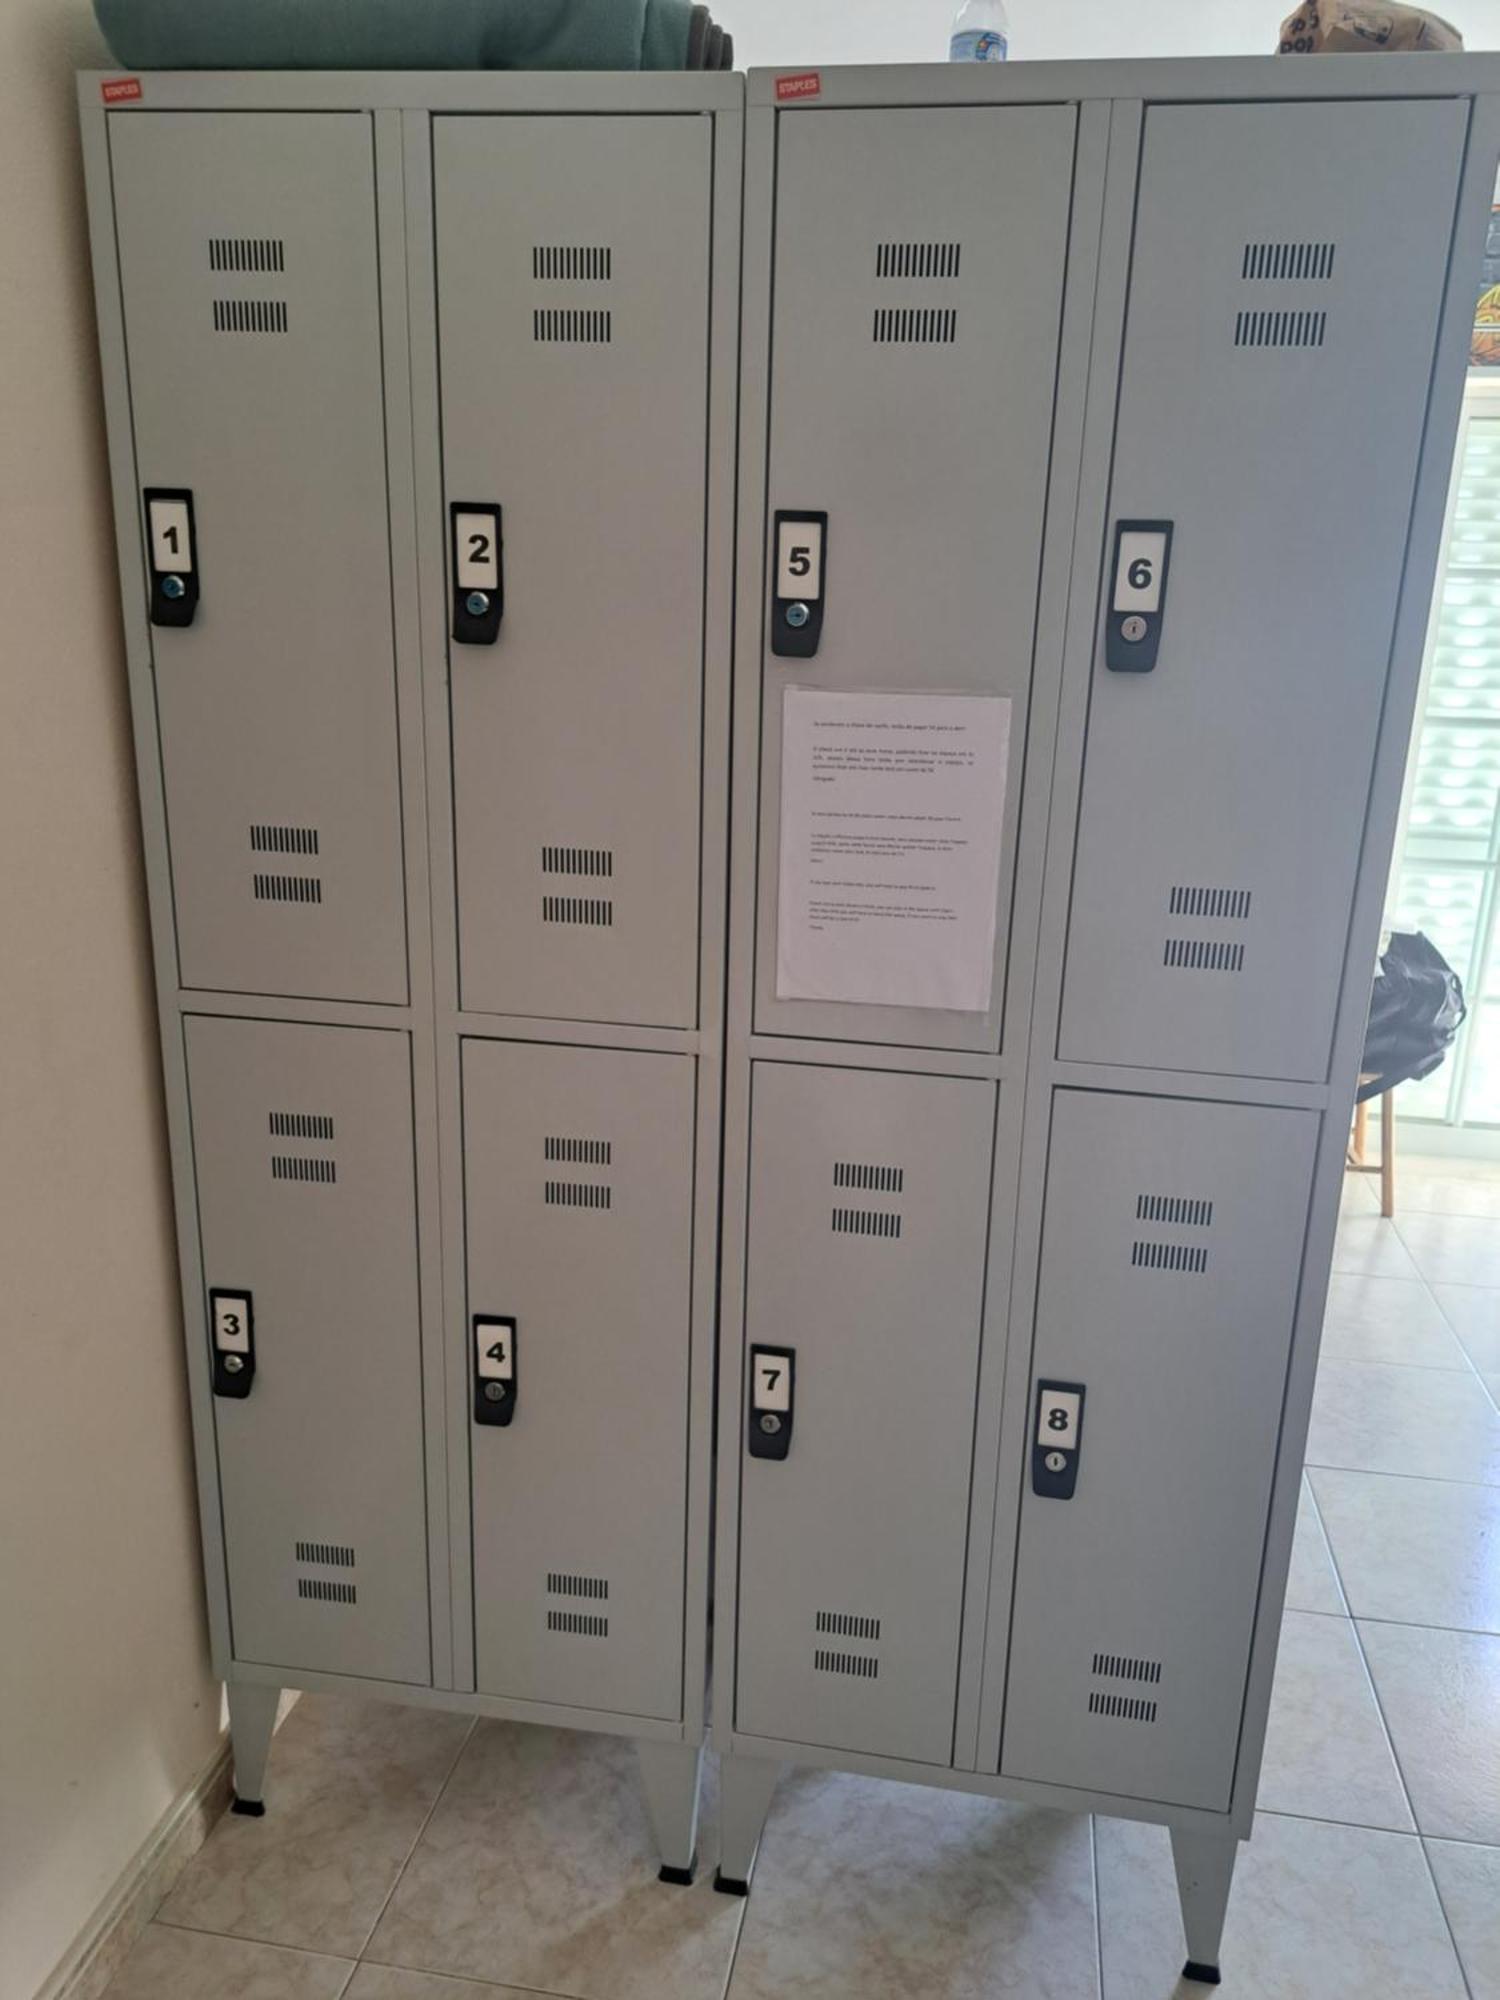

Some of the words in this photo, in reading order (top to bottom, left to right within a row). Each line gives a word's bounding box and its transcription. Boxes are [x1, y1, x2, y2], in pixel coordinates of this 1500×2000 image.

[162, 526, 179, 555] 1
[468, 534, 490, 563] 2
[788, 546, 811, 577] 5
[1127, 557, 1153, 590] 6
[223, 1313, 240, 1336] 3
[486, 1341, 506, 1363] 4
[762, 1369, 781, 1391] 7
[1047, 1408, 1069, 1432] 8
